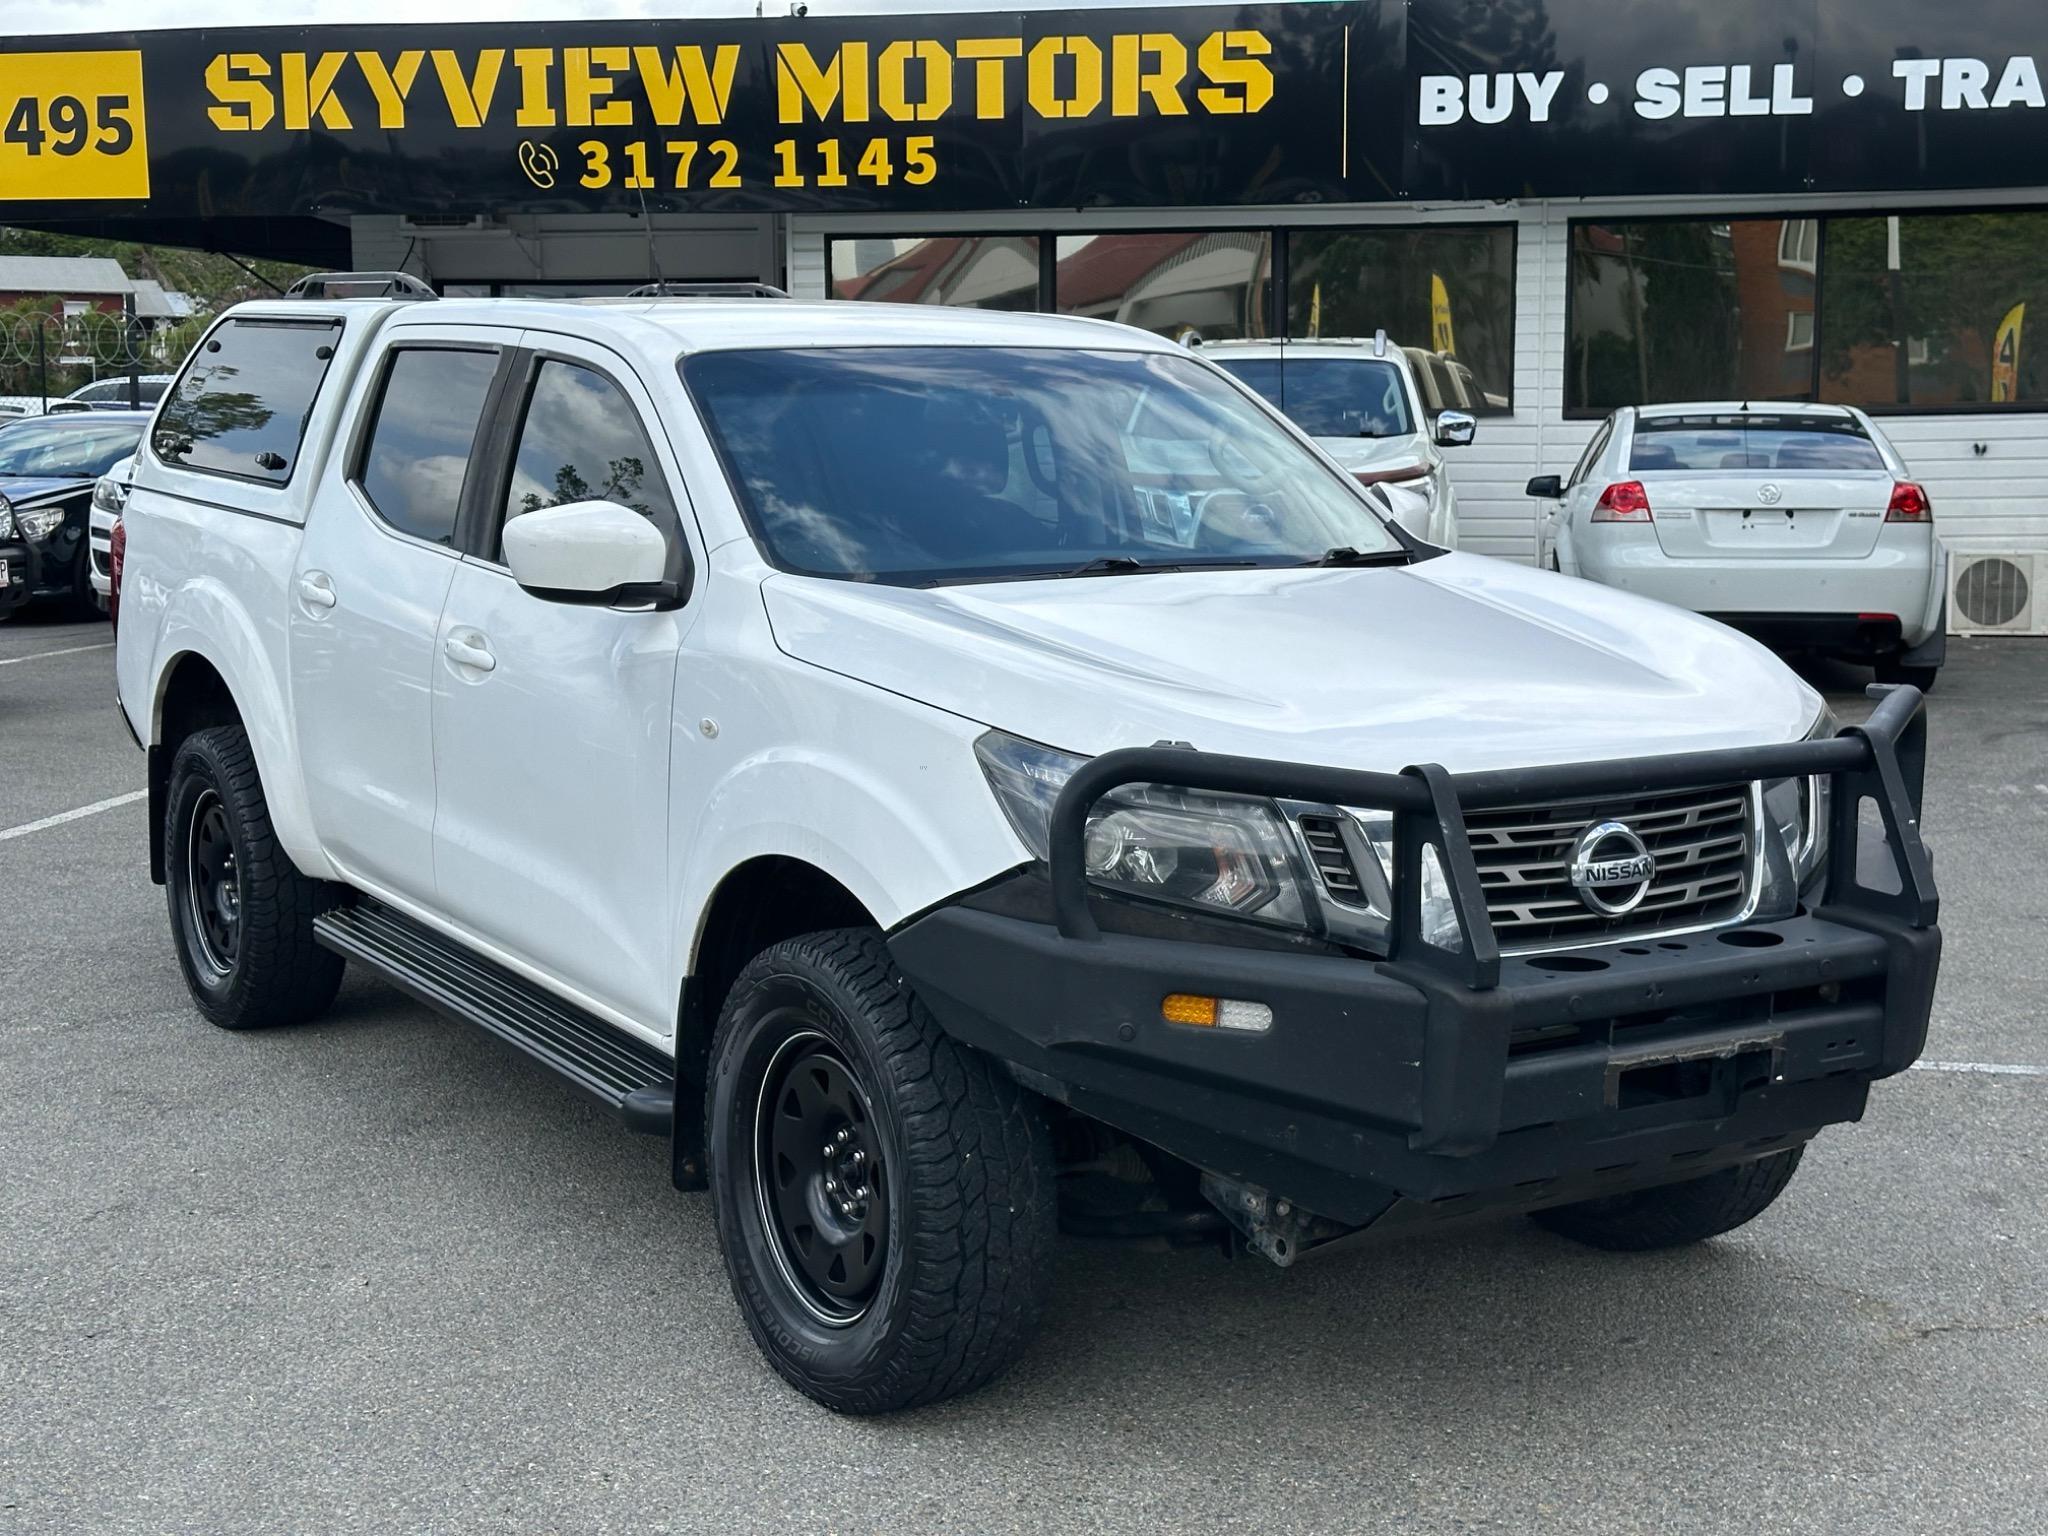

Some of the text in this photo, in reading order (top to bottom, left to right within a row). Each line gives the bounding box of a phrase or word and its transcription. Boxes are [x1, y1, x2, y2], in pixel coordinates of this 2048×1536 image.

[204, 30, 1274, 131] SKYVIEW MOTORS
[1419, 55, 2047, 126] BUY SELL TRA
[4, 96, 134, 156] 495
[579, 136, 937, 189] 3172 1145
[1586, 860, 1652, 882] NISSAN
